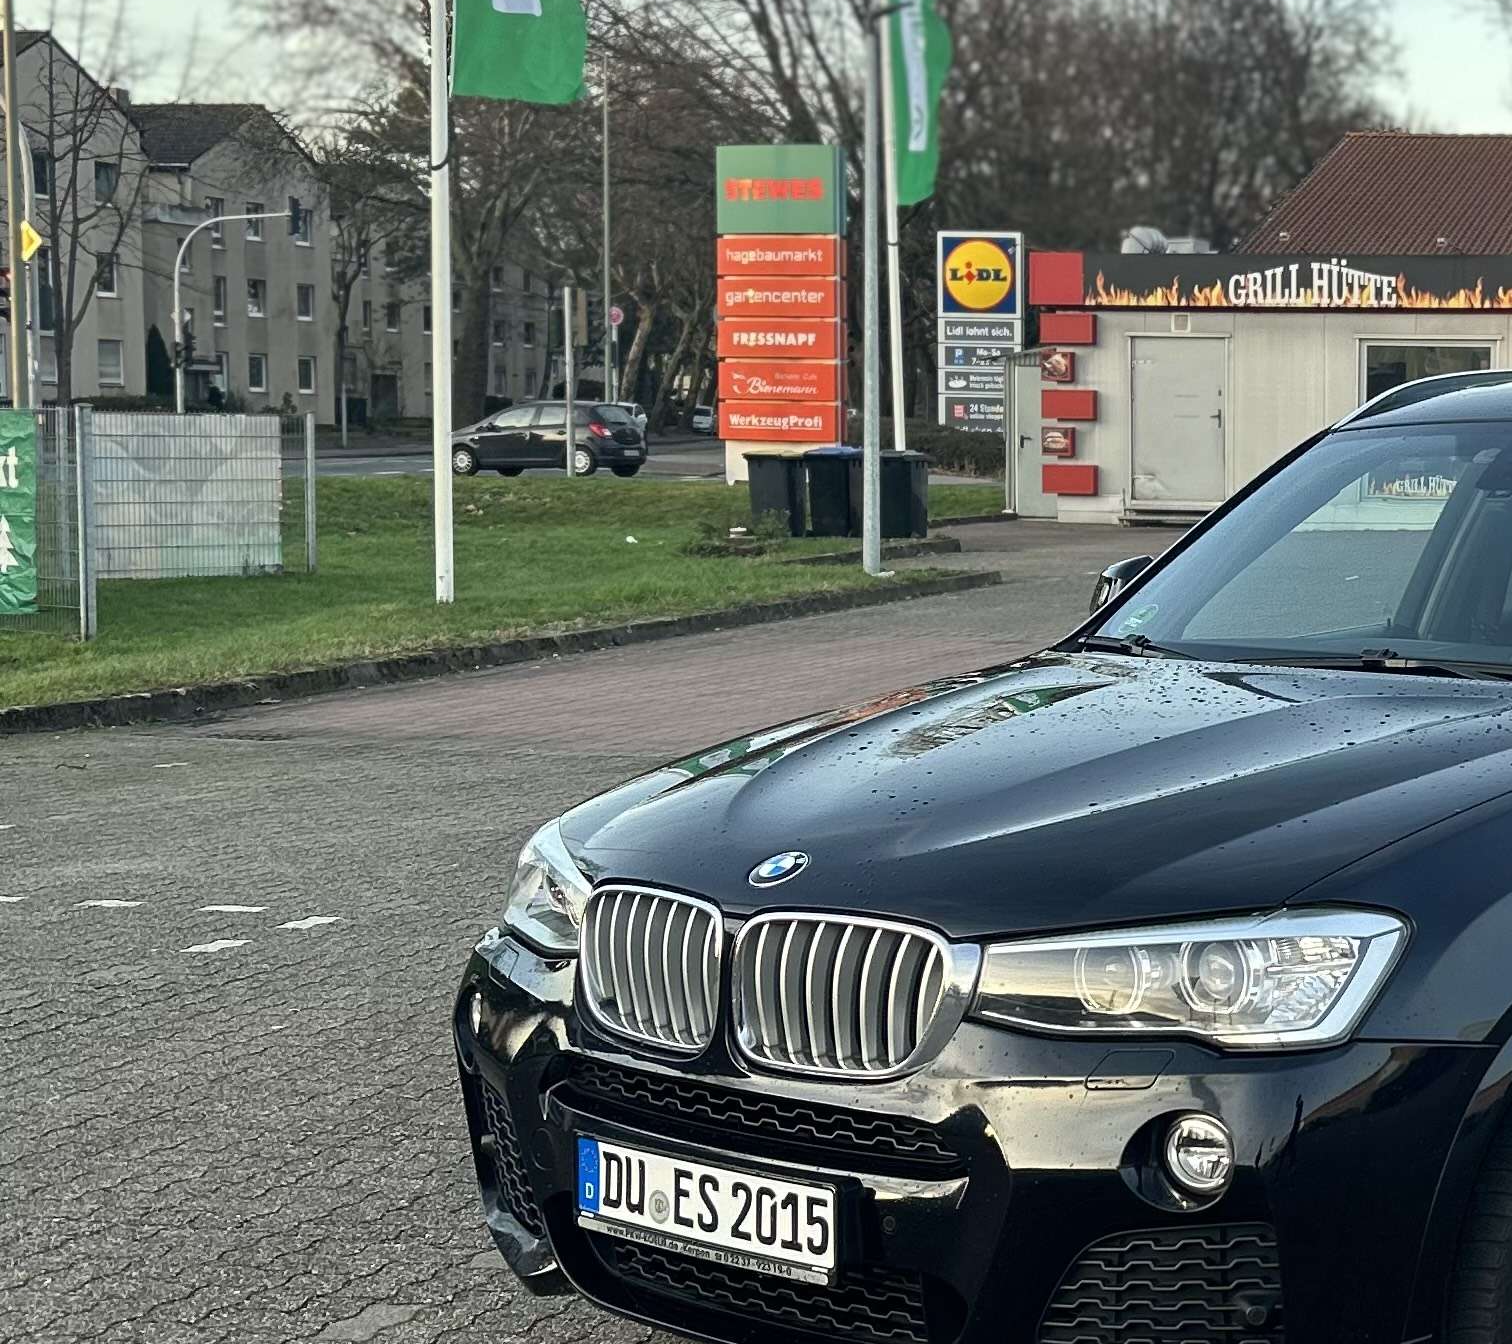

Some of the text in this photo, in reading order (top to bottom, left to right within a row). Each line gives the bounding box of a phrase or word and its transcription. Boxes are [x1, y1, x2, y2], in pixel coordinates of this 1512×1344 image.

[725, 178, 823, 201] STEWES
[726, 248, 823, 264] hagebaumarkt
[1228, 258, 1397, 307] GRILL HÜTTE
[725, 289, 824, 306] gartencenter
[733, 332, 816, 346] FRESSNAPF
[946, 326, 963, 336] Lidl
[729, 414, 822, 430] WerkzeugProfi
[585, 1182, 593, 1199] D
[602, 1151, 829, 1255] DU ES 2015
